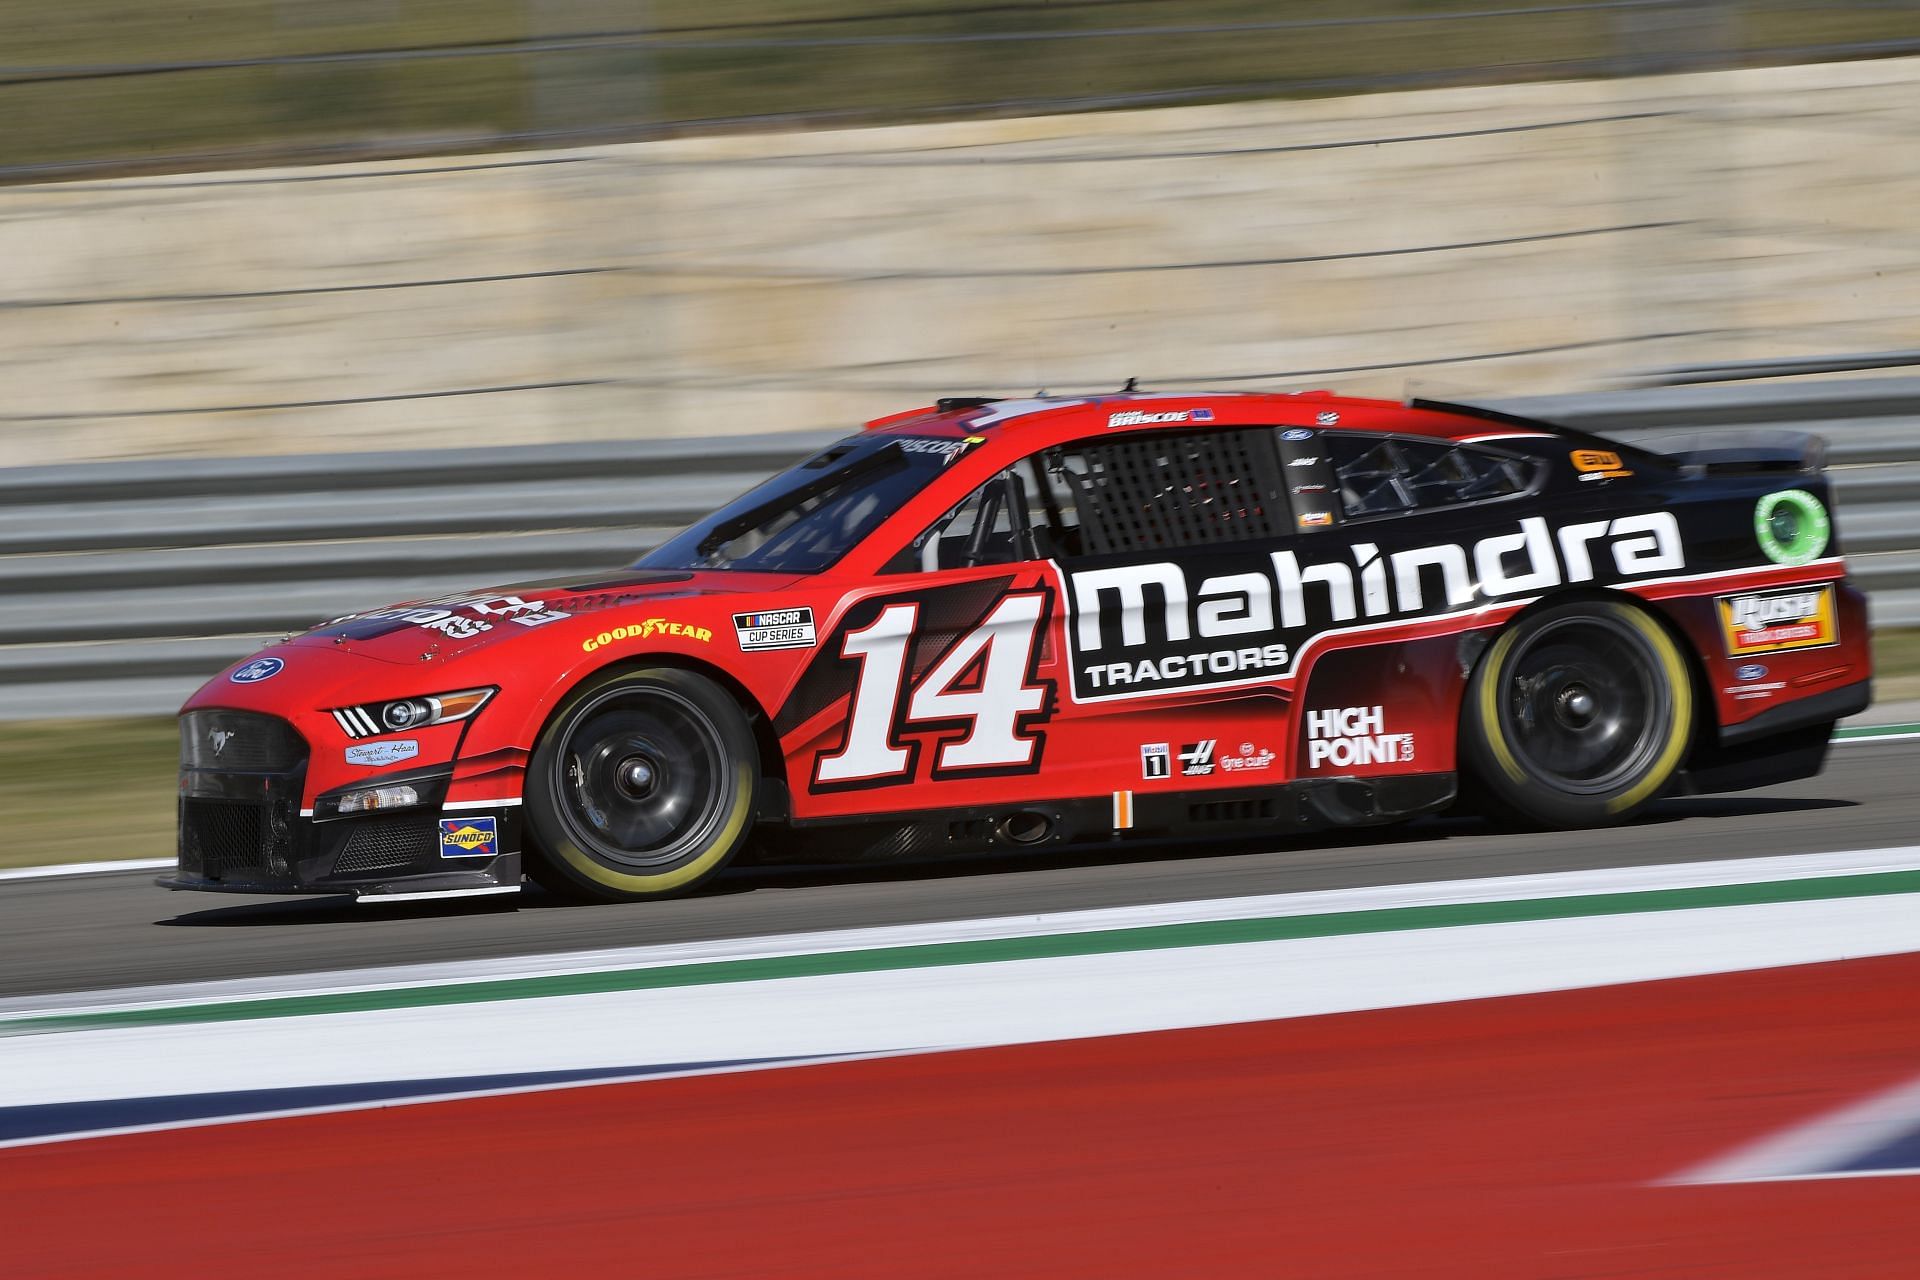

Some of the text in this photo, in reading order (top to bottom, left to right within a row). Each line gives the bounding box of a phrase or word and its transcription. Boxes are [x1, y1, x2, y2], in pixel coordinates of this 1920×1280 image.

[1107, 411, 1189, 427] BRISCOE
[1071, 511, 1686, 651] mahindra
[759, 611, 801, 625] NASCAR
[582, 620, 713, 652] GOODYEAR
[749, 628, 804, 642] CUP SERIES
[1084, 643, 1288, 688] TRACTORS
[816, 593, 1047, 783] 14
[1307, 705, 1384, 739] HIGH
[1150, 756, 1160, 775] 1
[446, 832, 492, 844] SUNOCO
